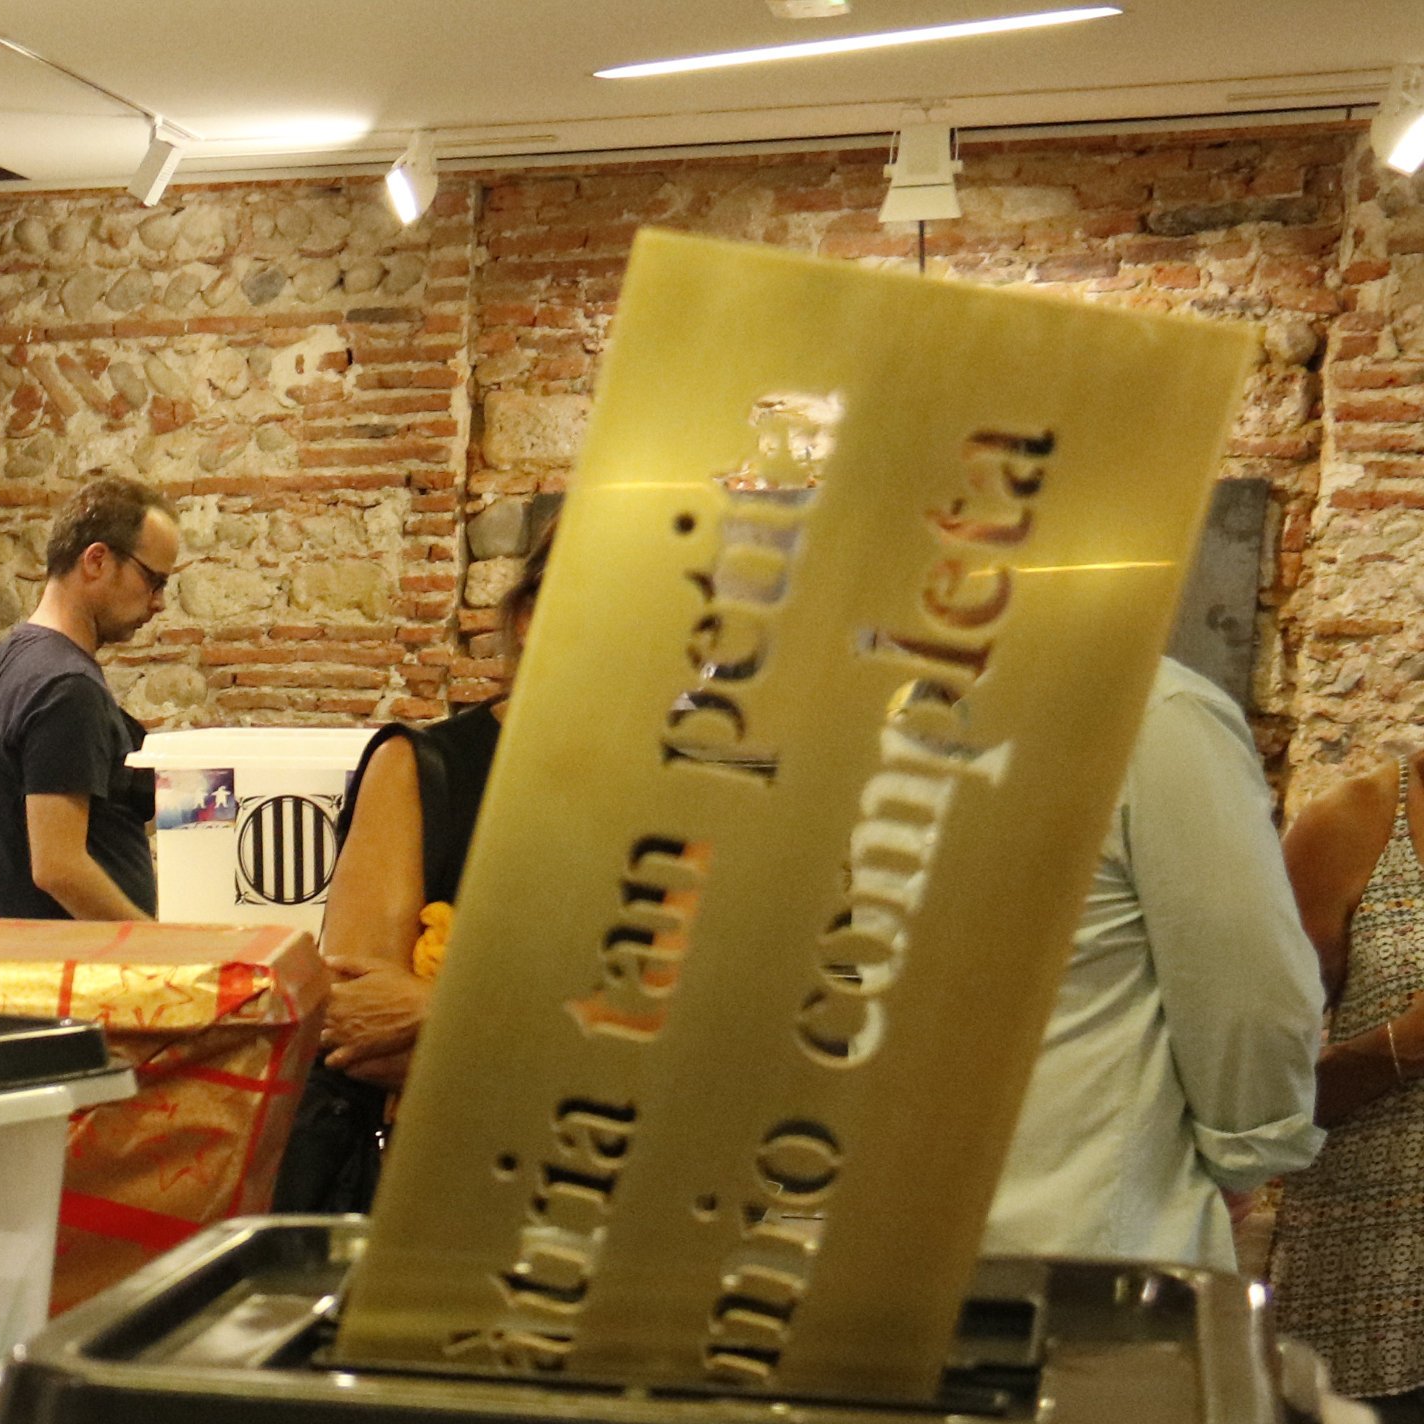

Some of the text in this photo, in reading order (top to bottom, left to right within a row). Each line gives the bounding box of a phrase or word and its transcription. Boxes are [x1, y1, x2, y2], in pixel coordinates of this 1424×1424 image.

[564, 834, 712, 1038] tan
[660, 394, 846, 786] petita
[795, 429, 1056, 1067] completa
